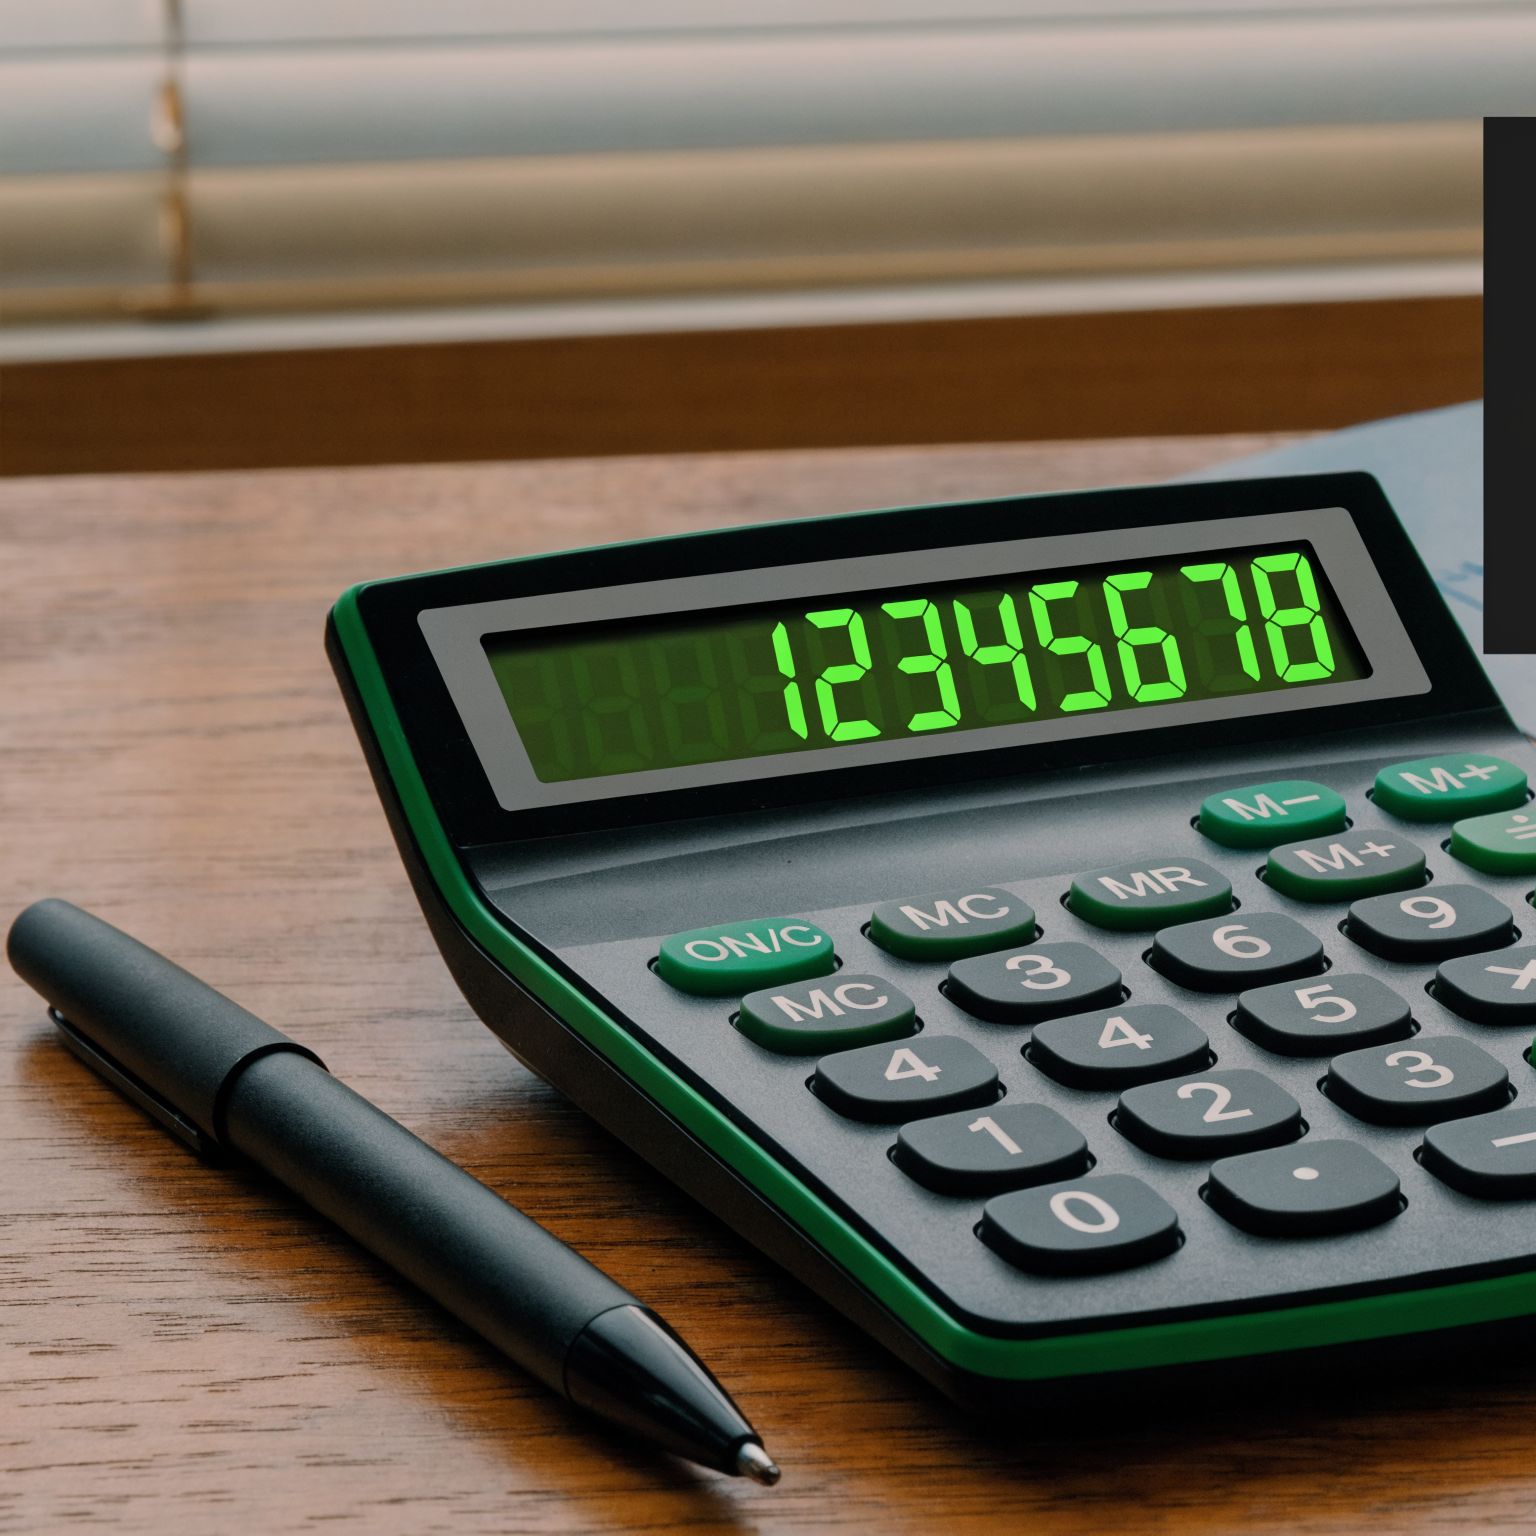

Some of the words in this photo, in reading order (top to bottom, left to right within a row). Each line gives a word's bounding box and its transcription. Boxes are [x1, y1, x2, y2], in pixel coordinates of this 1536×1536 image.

[771, 552, 1336, 742] 12345678
[1398, 763, 1500, 795] M+
[1292, 840, 1397, 874] M+
[1096, 864, 1210, 902] MR
[898, 892, 1010, 931] MC
[1399, 895, 1458, 930] 9
[684, 922, 823, 963] ON/C
[1211, 923, 1273, 959] 6
[1005, 953, 1073, 991] 3
[769, 980, 889, 1023] MC
[1294, 982, 1358, 1024] 5
[1097, 1015, 1154, 1050] 4
[883, 1046, 943, 1083] 4
[1384, 1048, 1456, 1089] 3
[1176, 1081, 1254, 1123] 2
[967, 1115, 1024, 1155] 1
[1049, 1189, 1121, 1234] 0
